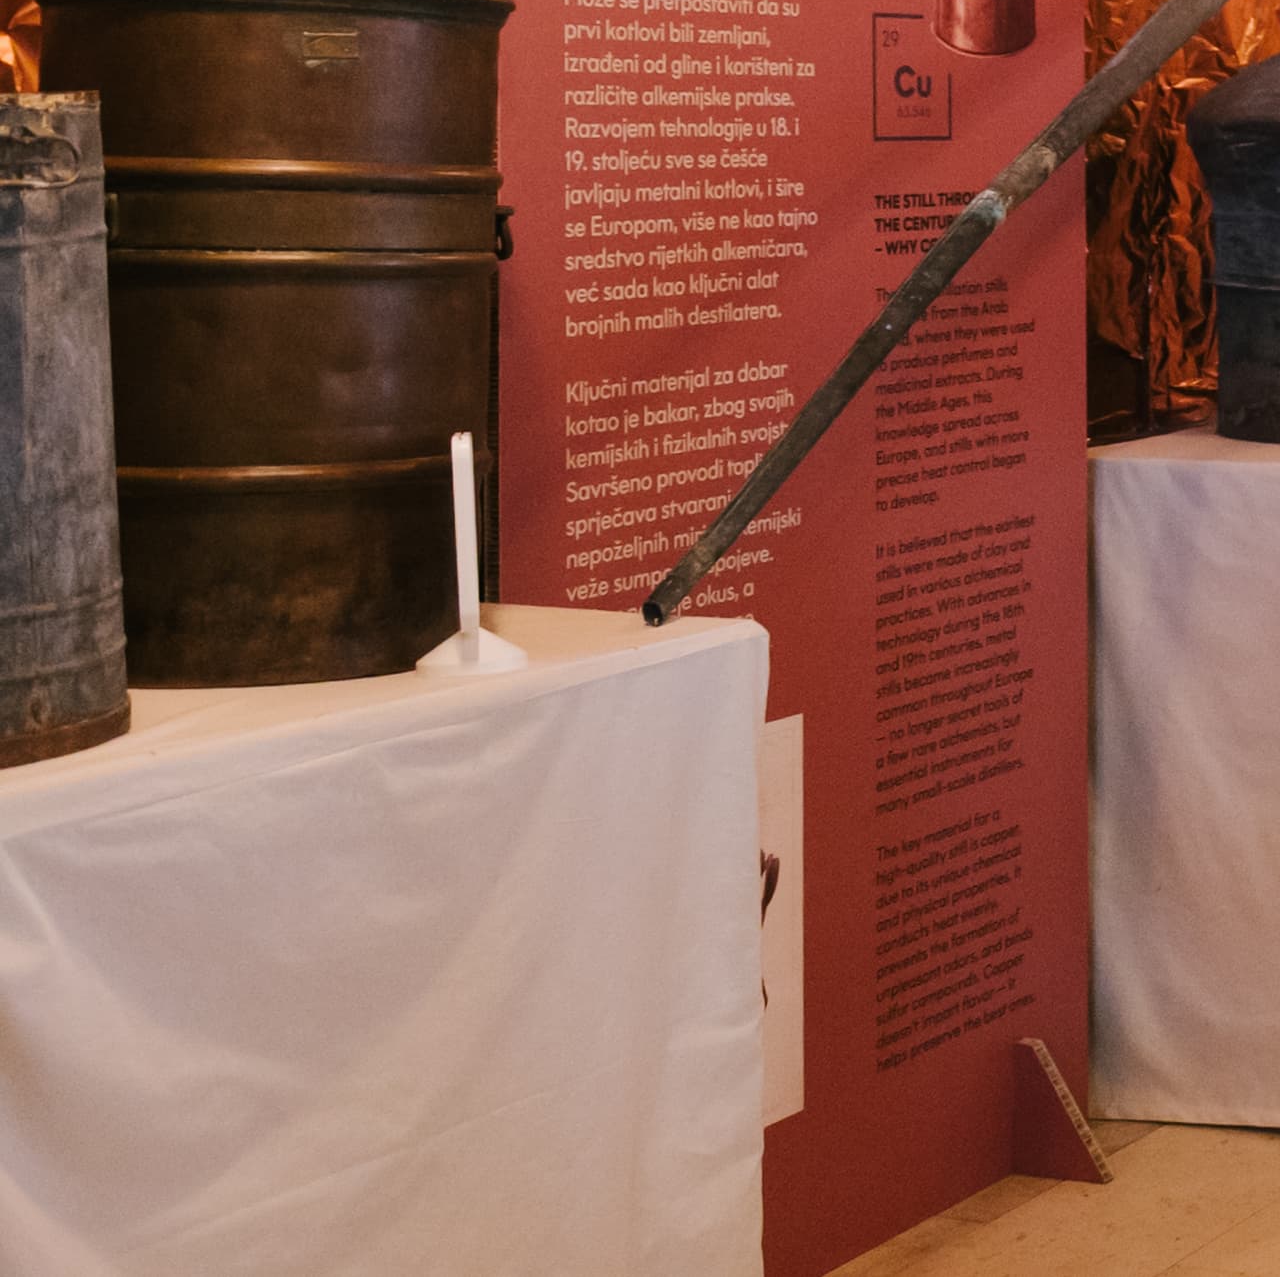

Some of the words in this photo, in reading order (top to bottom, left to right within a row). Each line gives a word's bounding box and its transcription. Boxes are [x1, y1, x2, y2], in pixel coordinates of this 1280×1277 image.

[782, 1, 801, 17] su
[563, 21, 602, 42] prvi
[605, 20, 666, 41] kotlovi
[669, 22, 695, 42] bili
[697, 25, 771, 47] zemljani,
[882, 30, 899, 48] 29
[563, 52, 640, 72] izrađeni
[642, 54, 667, 75] od
[670, 54, 713, 79] gline
[715, 56, 721, 76] i
[724, 56, 794, 75] korišteni
[796, 62, 816, 78] za
[894, 65, 932, 98] Cu
[874, 194, 900, 209] THE
[903, 193, 936, 209] STILL
[874, 217, 900, 233] THE
[884, 239, 917, 256] WHY
